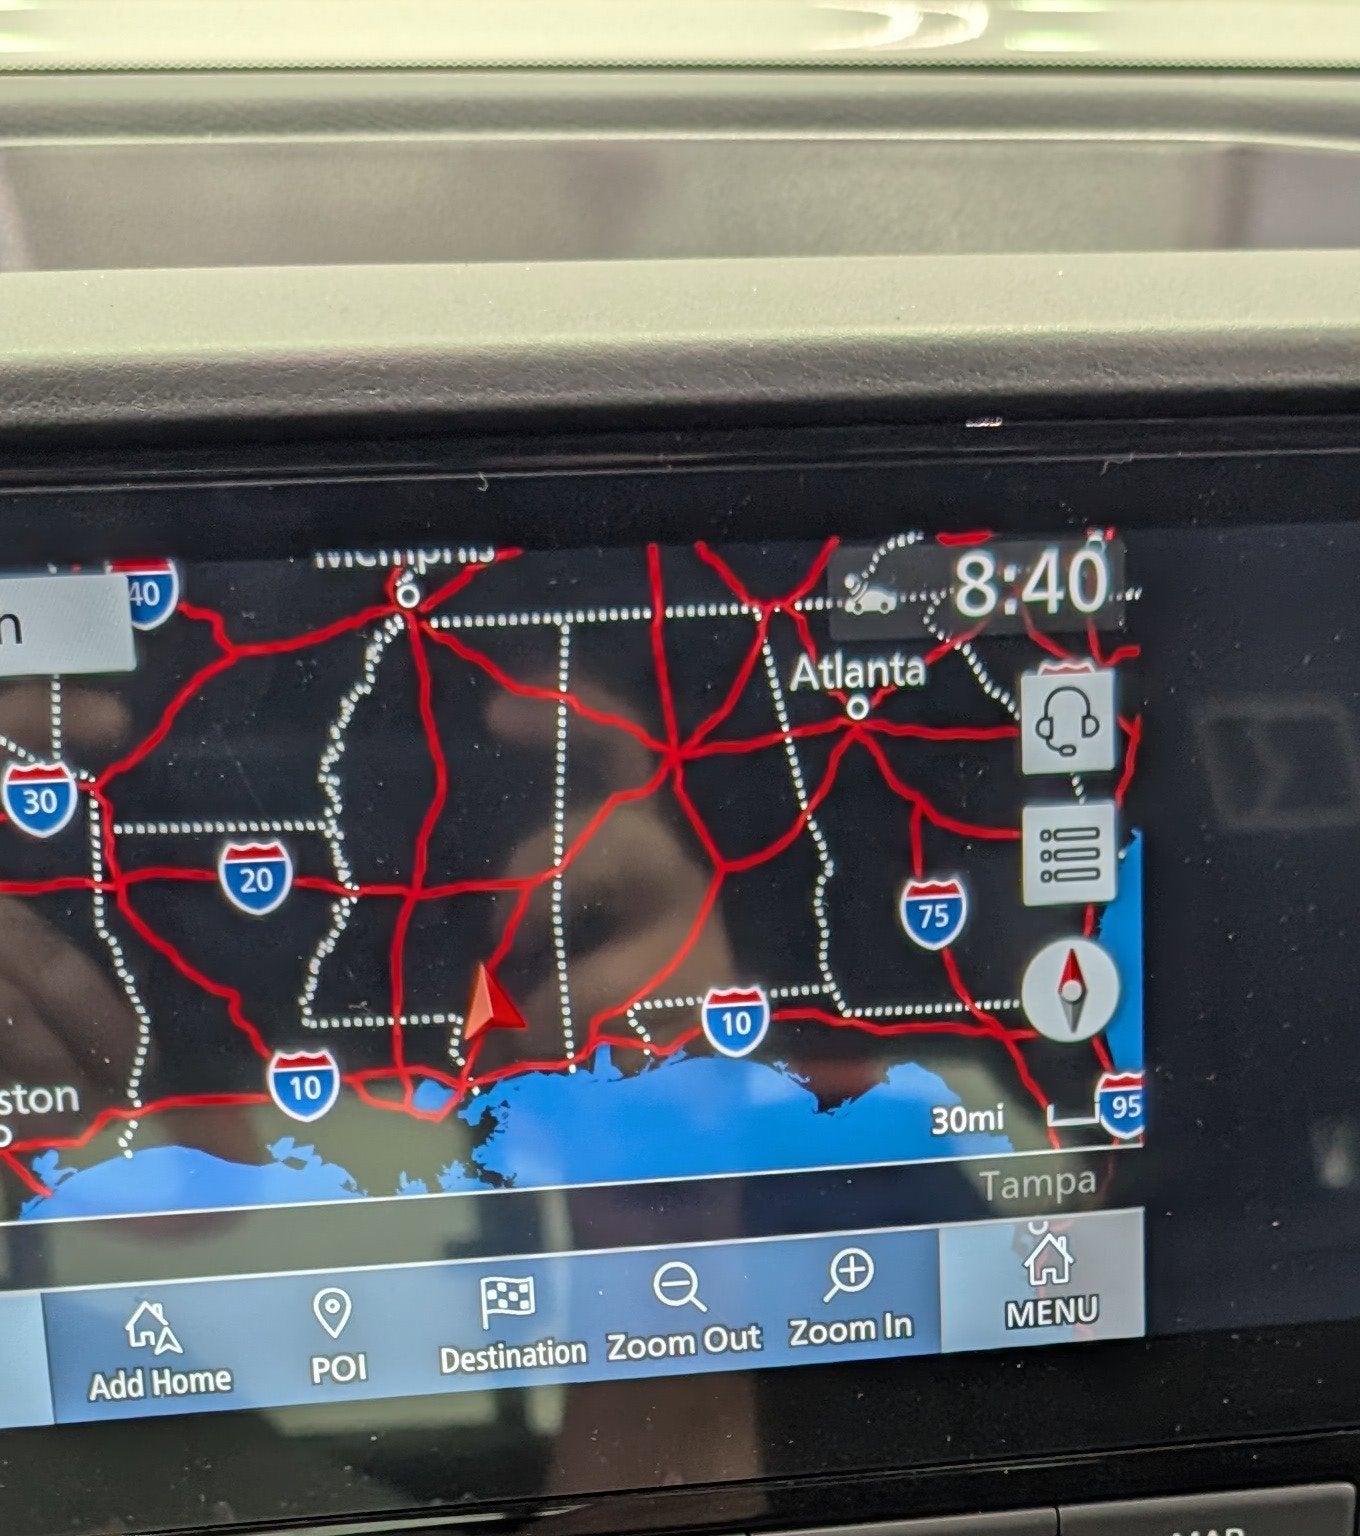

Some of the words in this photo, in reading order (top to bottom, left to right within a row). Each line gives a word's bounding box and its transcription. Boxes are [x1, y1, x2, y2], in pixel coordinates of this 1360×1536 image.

[128, 580, 160, 607] 40
[955, 546, 1109, 617] 8:40
[790, 653, 927, 693] Atlanta
[23, 789, 58, 814] 30
[240, 868, 273, 894] 20
[918, 903, 950, 928] 75
[722, 1012, 751, 1037] 10
[290, 1077, 321, 1100] 10
[931, 1104, 1005, 1135] 30mi
[1112, 1095, 1142, 1120] 95
[979, 1166, 1097, 1204] Tampa
[1005, 1294, 1100, 1331] MENU
[607, 1331, 696, 1362] Zoom
[704, 1325, 762, 1356] Out
[789, 1318, 877, 1348] Zoom
[884, 1313, 914, 1341] In
[310, 1353, 367, 1385] POI
[440, 1340, 588, 1374] Destination
[89, 1370, 145, 1403] Add
[152, 1367, 234, 1397] Home
